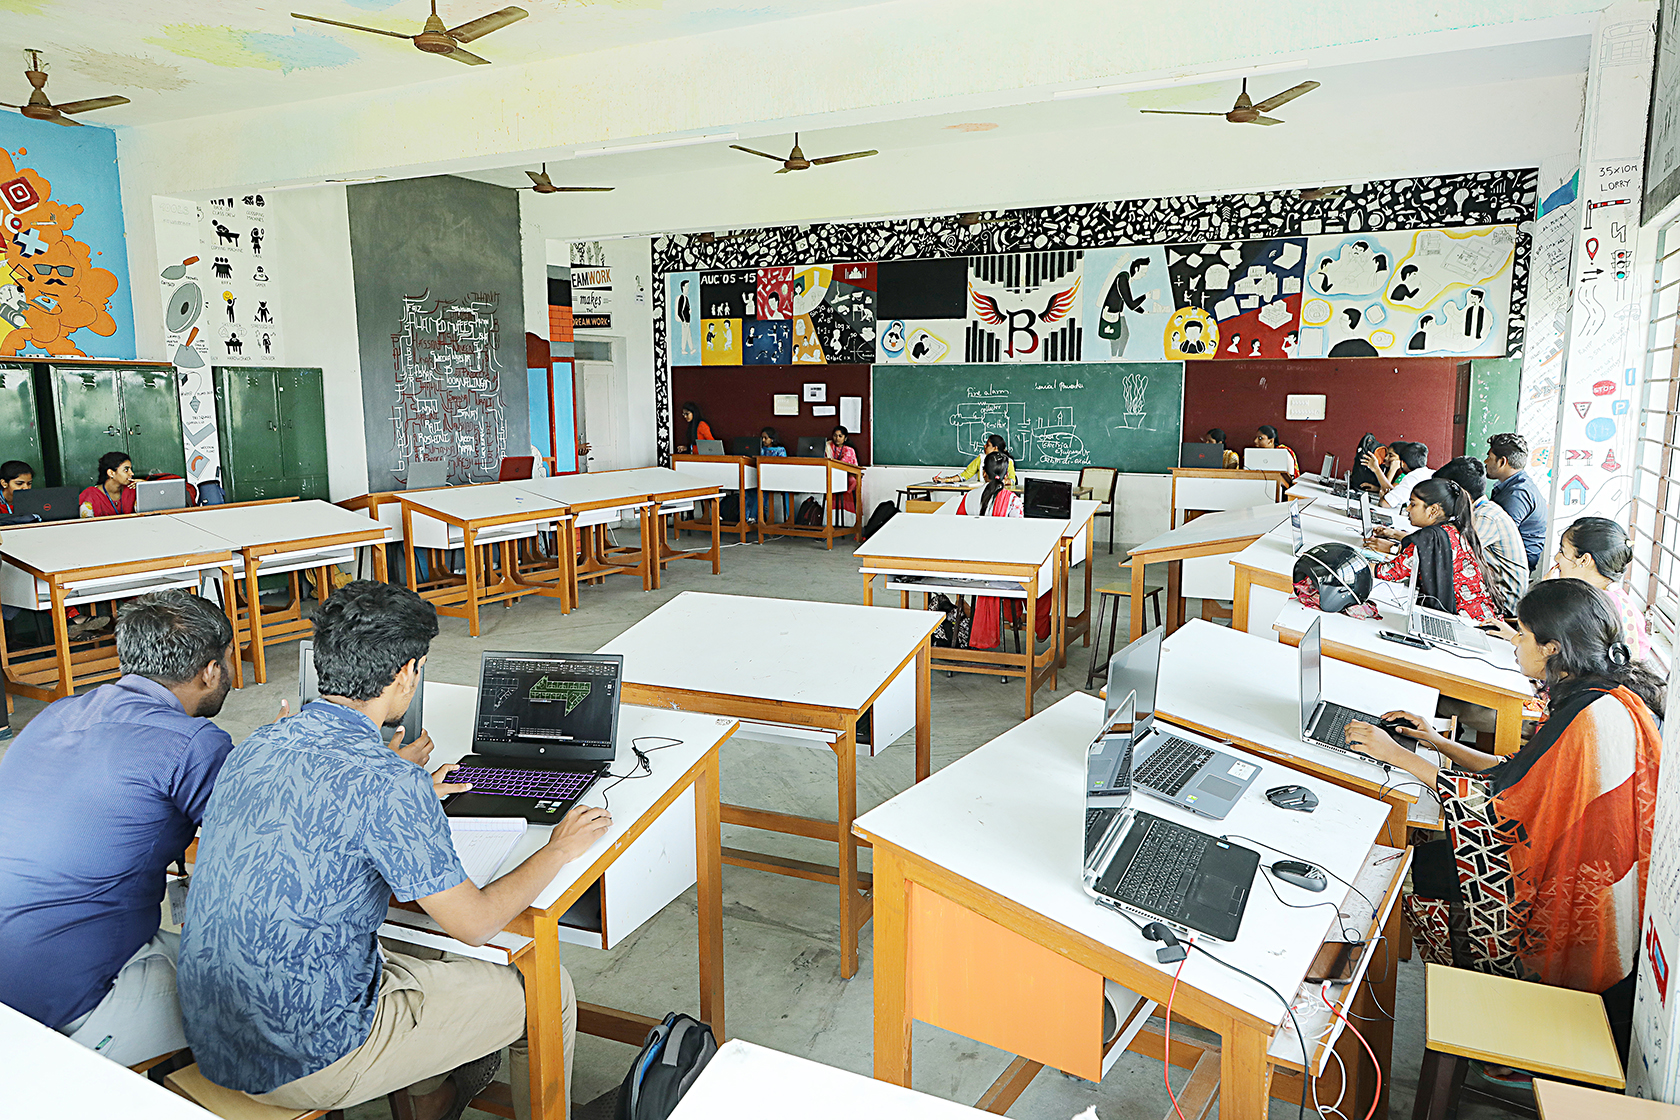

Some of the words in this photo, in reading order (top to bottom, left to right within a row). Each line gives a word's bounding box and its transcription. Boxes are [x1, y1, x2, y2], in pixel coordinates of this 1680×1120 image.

[1600, 179, 1631, 191] LORRY
[571, 268, 612, 287] EAMWORK
[579, 291, 602, 308] makes
[592, 317, 608, 325] WORK
[1003, 308, 1040, 358] B
[1594, 385, 1615, 393] STOP
[1615, 402, 1626, 415] P
